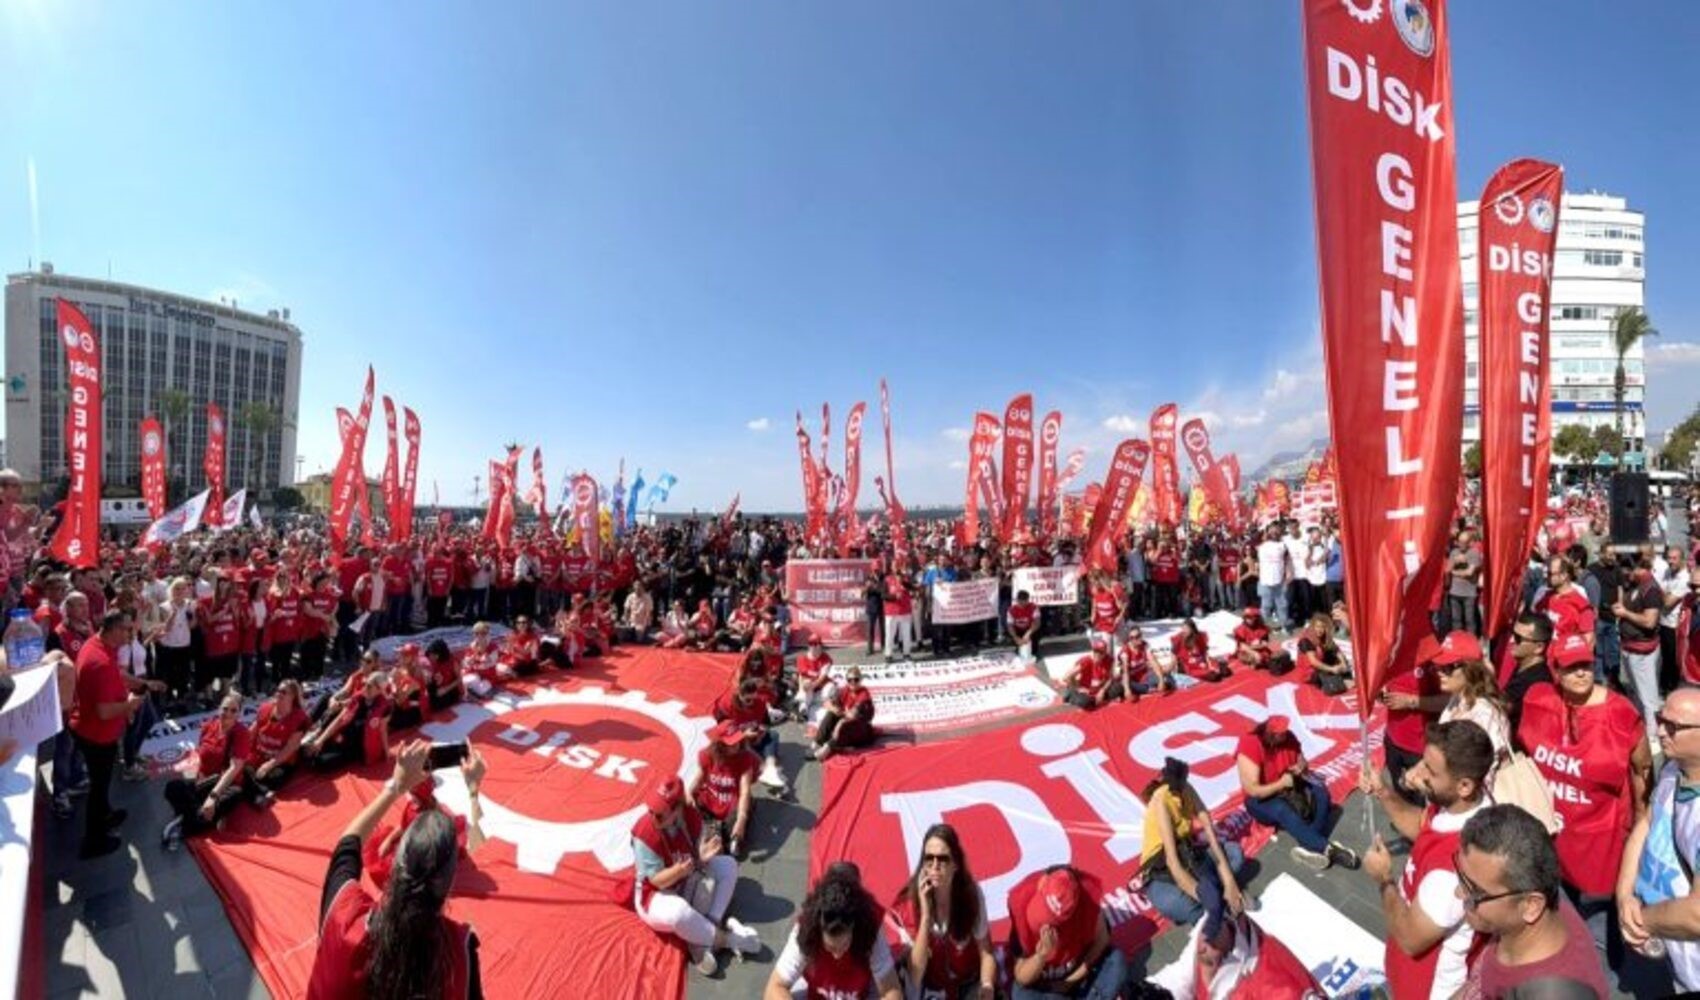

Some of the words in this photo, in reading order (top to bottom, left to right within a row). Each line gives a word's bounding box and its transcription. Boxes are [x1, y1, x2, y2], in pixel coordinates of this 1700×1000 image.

[1327, 46, 1444, 142] DİSK
[1375, 152, 1424, 476] GENEL
[495, 723, 648, 784] DİSK
[1533, 744, 1583, 777] DİSK
[1547, 781, 1592, 804] NEL
[880, 681, 1360, 924] DİSK
